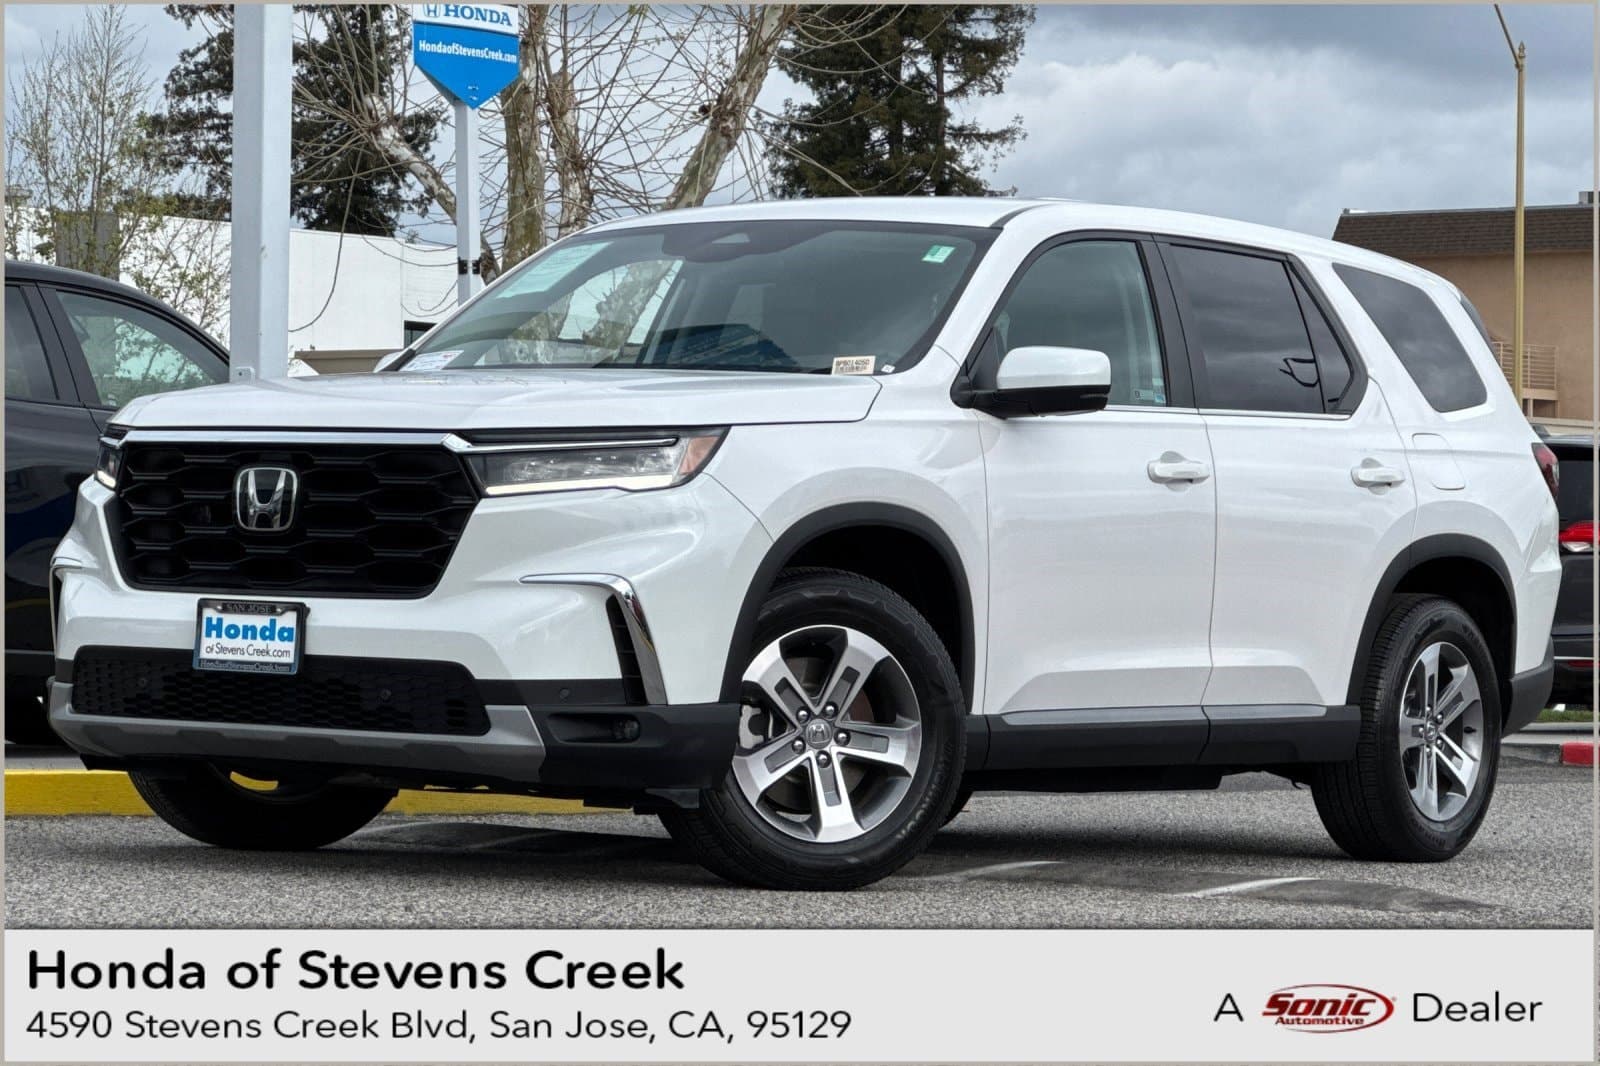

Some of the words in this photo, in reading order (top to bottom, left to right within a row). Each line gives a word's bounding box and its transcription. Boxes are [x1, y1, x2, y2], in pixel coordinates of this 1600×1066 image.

[444, 4, 513, 26] HONDA
[418, 39, 517, 64] HondaofStevensCreek.com
[226, 603, 245, 613] SAN
[247, 604, 273, 614] JOSE
[205, 616, 295, 642] Honda
[205, 643, 215, 654] of
[215, 642, 246, 656] Stevens
